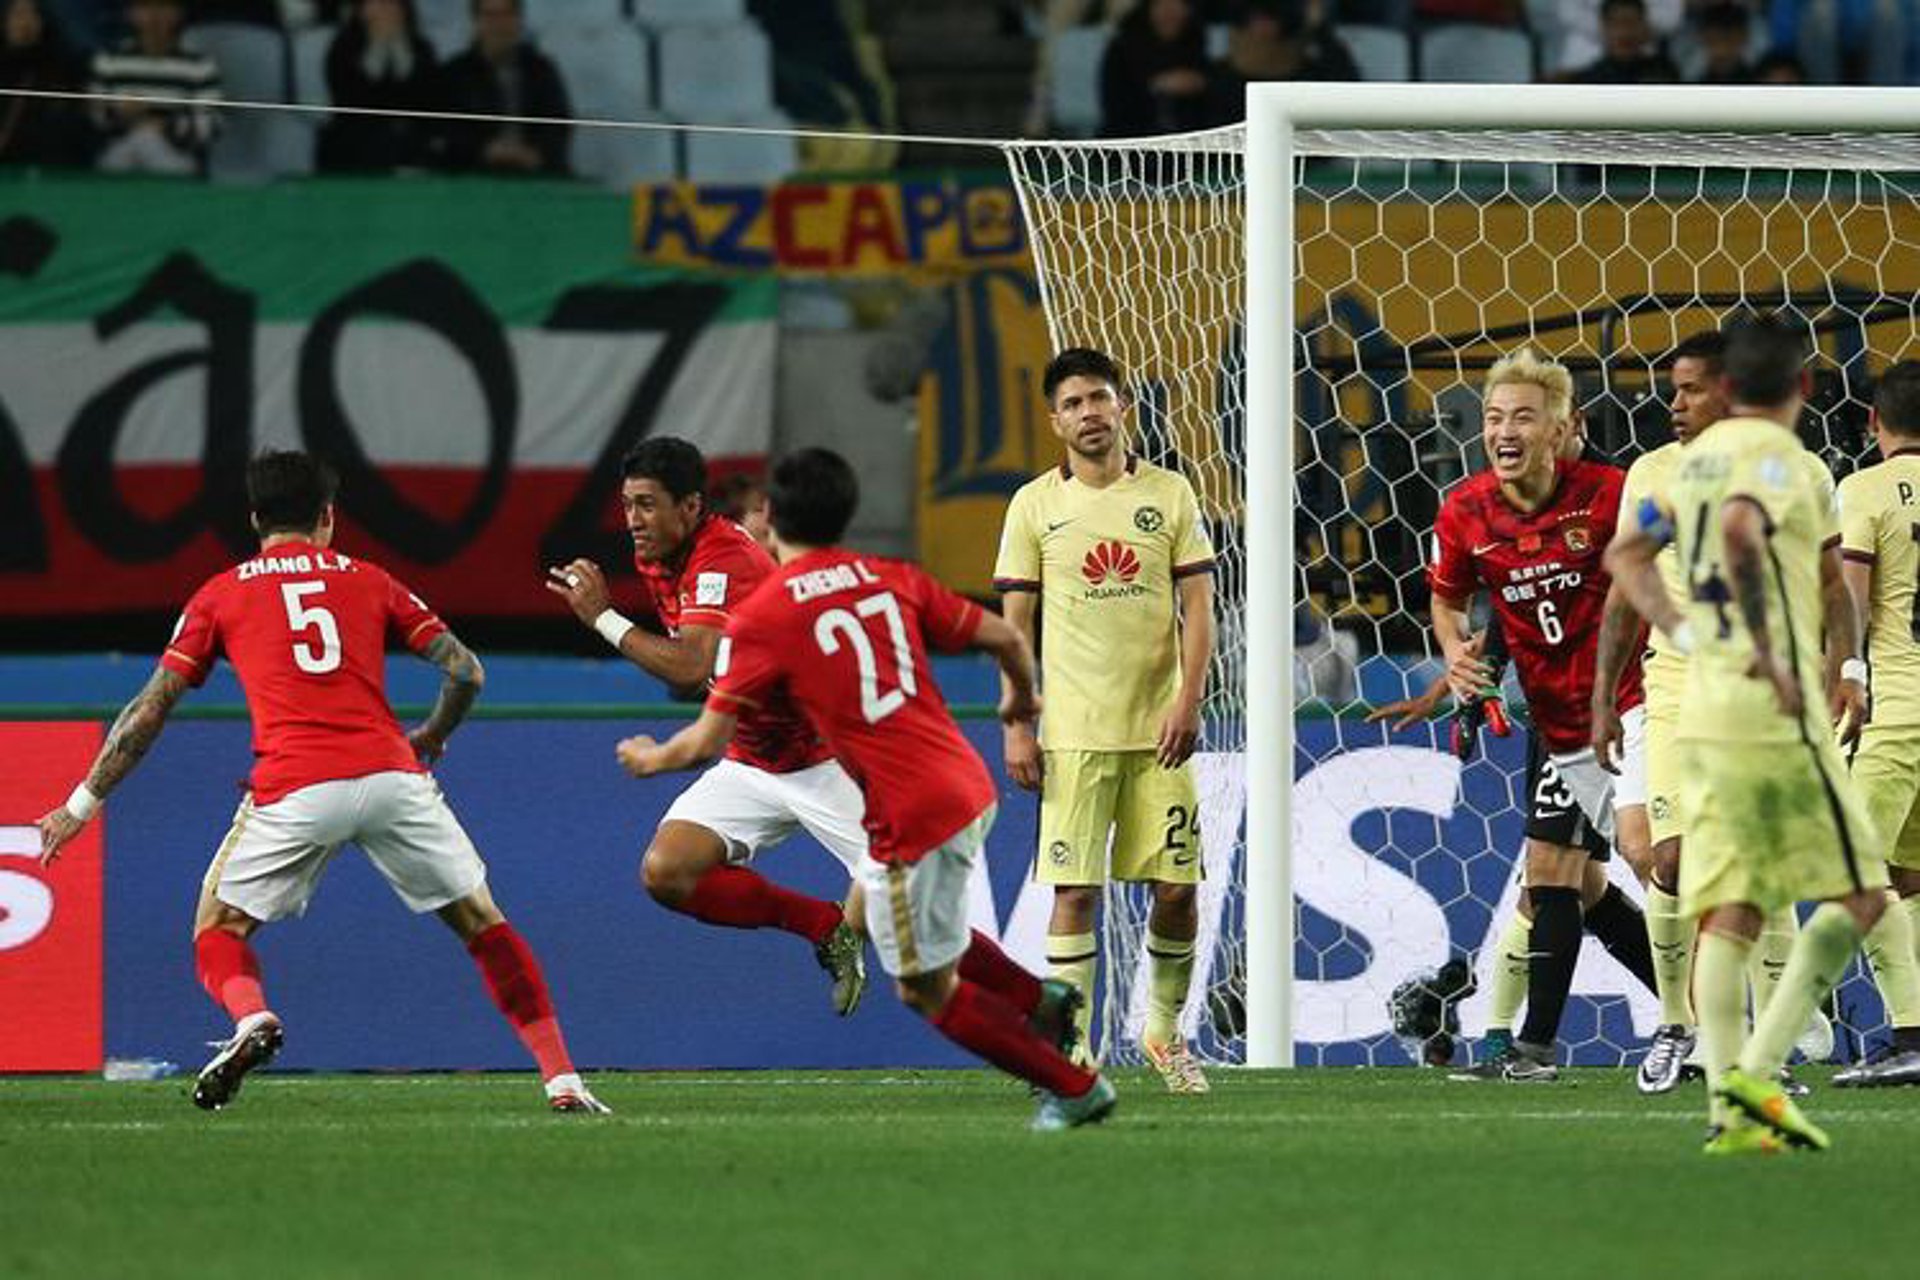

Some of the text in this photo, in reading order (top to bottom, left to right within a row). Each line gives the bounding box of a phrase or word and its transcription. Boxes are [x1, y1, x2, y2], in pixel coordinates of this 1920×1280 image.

[237, 555, 312, 581] ZHANG
[280, 580, 342, 675] 5
[1537, 600, 1564, 645] 6
[813, 591, 918, 725] 27
[1166, 803, 1201, 850] 24
